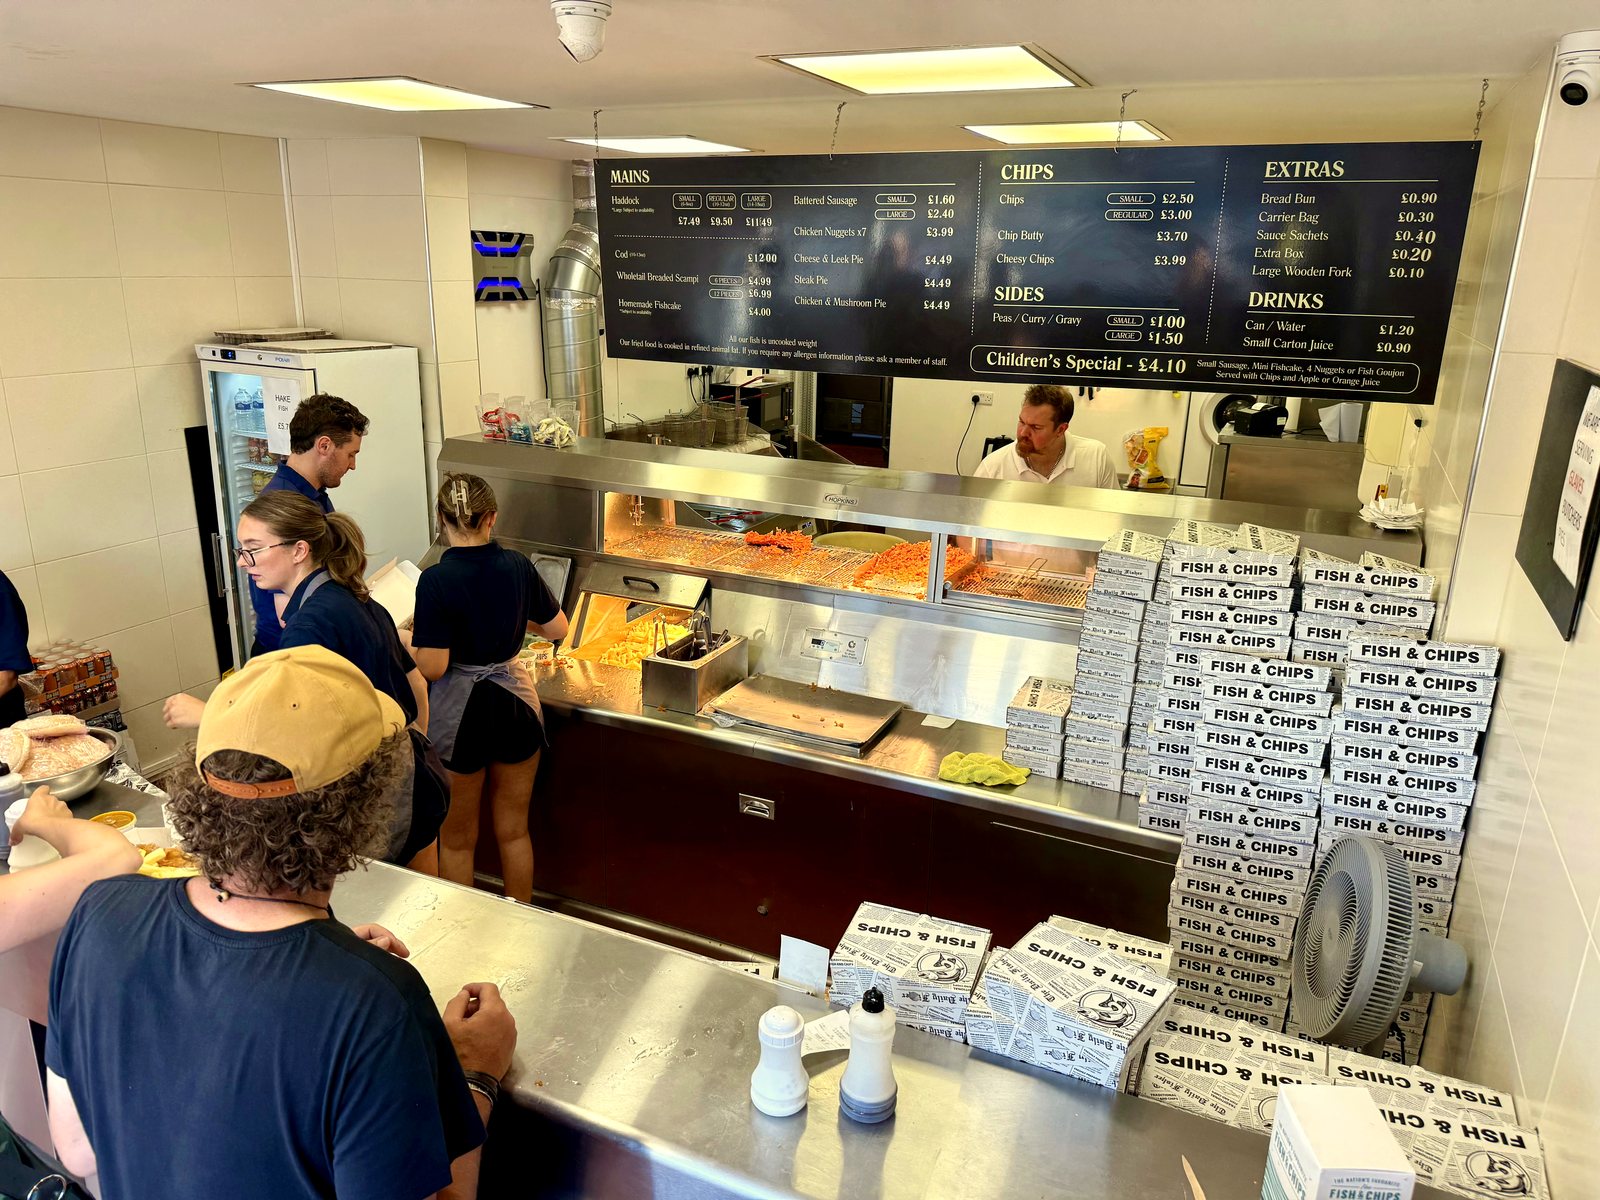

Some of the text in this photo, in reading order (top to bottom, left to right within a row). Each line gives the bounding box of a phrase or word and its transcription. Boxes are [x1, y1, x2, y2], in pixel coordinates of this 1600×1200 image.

[1001, 164, 1054, 180] CHIPS
[1265, 160, 1344, 178] EXTRAS
[610, 170, 650, 183] MAINS
[612, 196, 639, 205] Haddock
[794, 196, 824, 204] Battered
[827, 196, 857, 207] Sausage
[928, 195, 955, 204] £1.60
[1000, 194, 1024, 206] Chips
[1163, 194, 1193, 204] £2.50
[1261, 193, 1437, 204] Bread Bun £0.90
[928, 209, 954, 218] £2.40
[1161, 210, 1192, 219] £3.00
[1259, 212, 1434, 225] Carrier Bag £0.30
[678, 217, 700, 225] £7.49
[711, 217, 732, 225] £9.50
[794, 227, 953, 238] Chicken Nuggets x7 £3.99
[998, 231, 1187, 242] Chip Butty £3.70
[1256, 230, 1436, 245] Sauce Sachets £0.40
[615, 250, 628, 258] Cod
[794, 254, 952, 265] Cheese & Leek Pie £4.49
[997, 254, 1186, 266] Cheesy Chips £3.99
[1254, 248, 1431, 262] Extra Box £0.20
[617, 272, 771, 285] Wholetail Breaded Scampi £4.99
[1252, 266, 1424, 278] Large Wooden Fork £0.10
[795, 276, 951, 287] Steak Pie £4.49
[749, 290, 771, 298] £6.99
[994, 287, 1044, 302] SIDES
[1249, 291, 1324, 309] DRINKS
[619, 299, 770, 316] Homemade Fishcake £4.00
[795, 296, 950, 309] Chicken & Mushroom Pie £4.49
[993, 313, 1012, 323] Peas
[1021, 314, 1045, 325] Curry
[1056, 315, 1082, 326] Gravy
[1150, 316, 1185, 329] £1.00
[1245, 320, 1265, 330] Can
[1276, 321, 1306, 332] Water
[1379, 325, 1414, 336] £1.20
[1243, 337, 1411, 353] Small Carton Juice £0.90
[645, 340, 656, 348] food
[760, 349, 780, 357] require
[782, 351, 792, 359] any
[794, 351, 817, 360] allergen
[819, 352, 853, 361] information
[855, 354, 874, 363] please
[895, 356, 921, 364] member
[932, 358, 947, 366] staff.
[1066, 354, 1121, 372] Special
[1138, 358, 1186, 373] £4.10
[1197, 360, 1216, 368] Small
[1219, 360, 1249, 370] Sausage,
[1252, 362, 1269, 370] Mini
[1271, 363, 1304, 372] Fishcake,
[1306, 364, 1312, 372] 4
[1314, 365, 1345, 375] Nuggets
[1358, 367, 1374, 375] Fish
[1376, 368, 1405, 377] Goujon
[1216, 371, 1241, 379] Served
[1242, 371, 1258, 380] with
[1260, 372, 1281, 382] Chips
[1283, 374, 1296, 382] and
[1298, 375, 1320, 384] Apple
[1332, 376, 1359, 386] Orange
[1361, 378, 1380, 386] Juice
[1181, 563, 1277, 576] FISH & CHIPS
[1362, 645, 1479, 663] FISH & CHIPS
[1193, 856, 1293, 880] FISH & CHIPS
[858, 923, 976, 949] FISH & CHIPS
